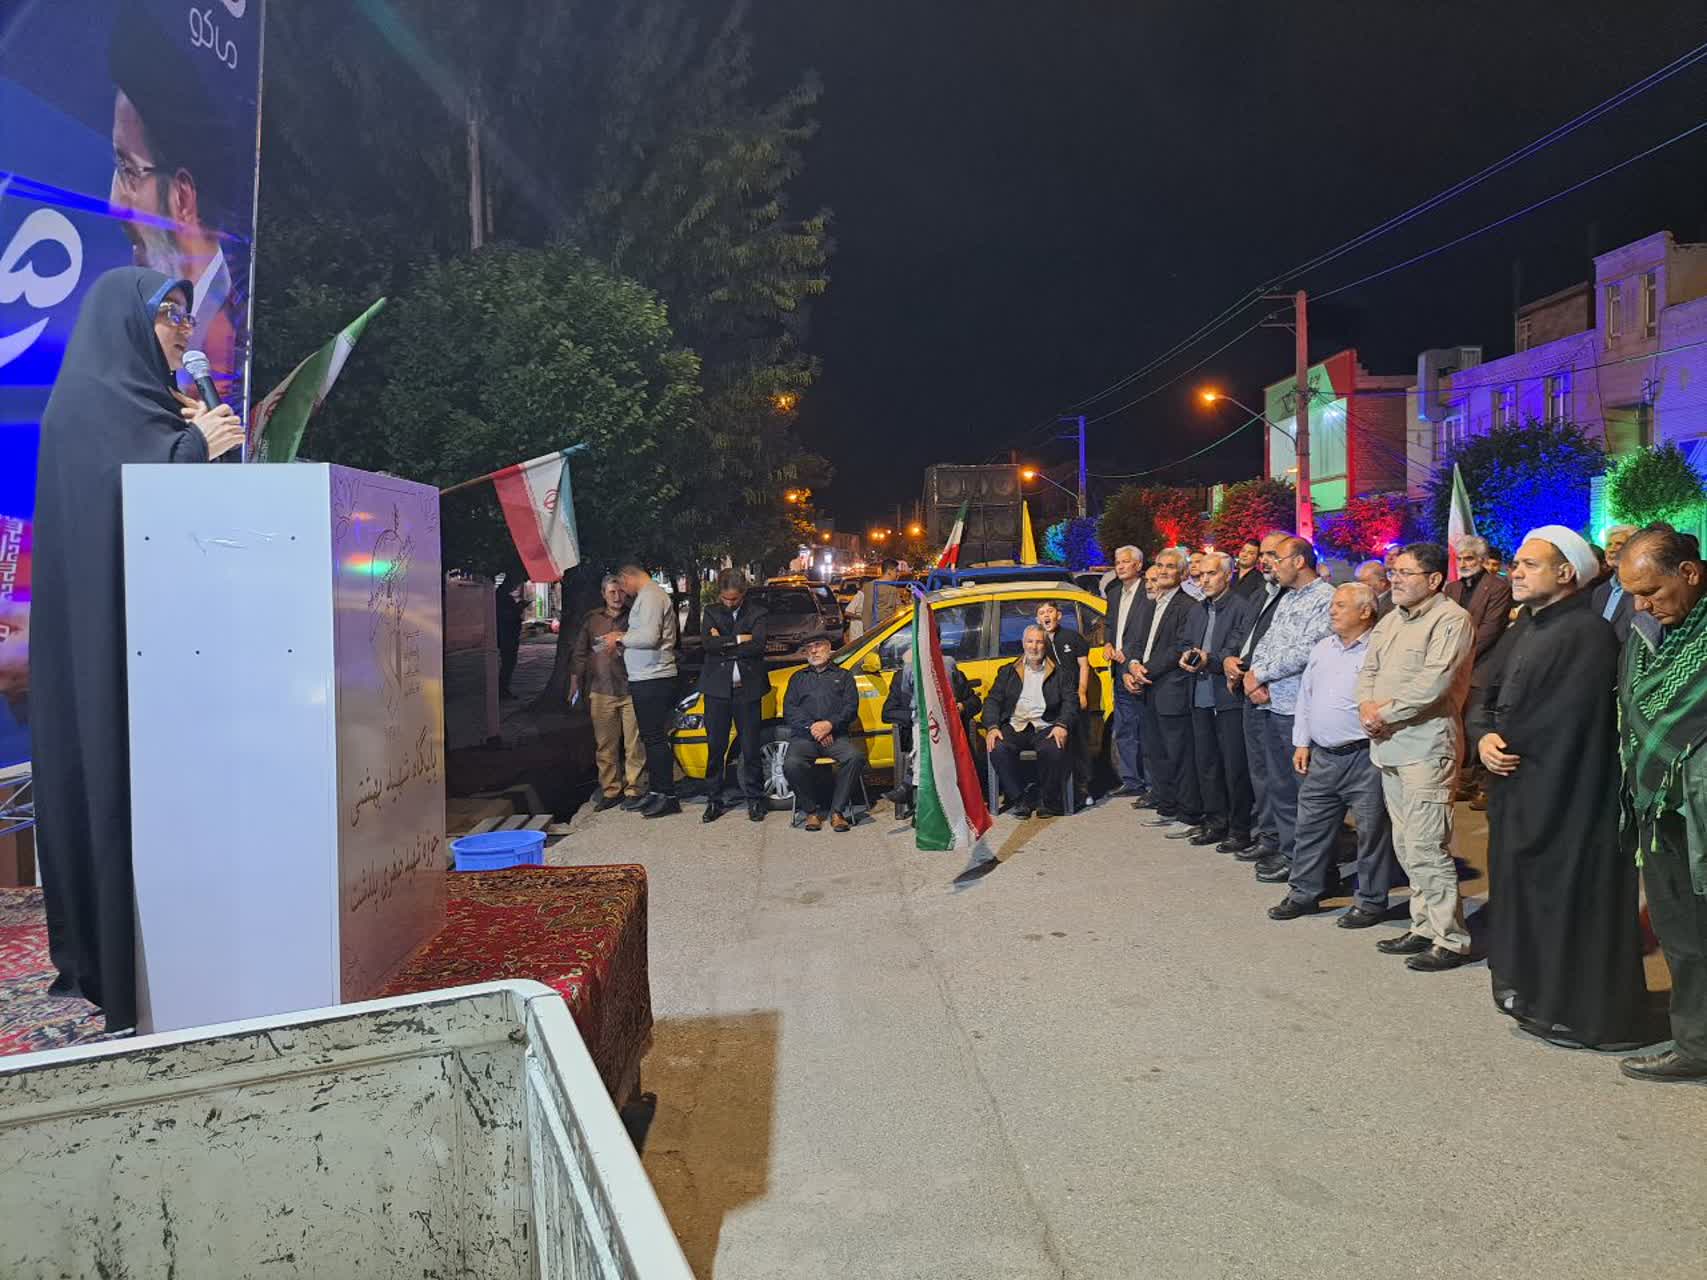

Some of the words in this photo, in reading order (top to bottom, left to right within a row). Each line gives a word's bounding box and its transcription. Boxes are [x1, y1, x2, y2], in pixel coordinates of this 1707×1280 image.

[189, 7, 238, 70] ماکو
[386, 751, 409, 804] شهید
[413, 725, 437, 784] پایگاه
[350, 767, 383, 828] بهشتی
